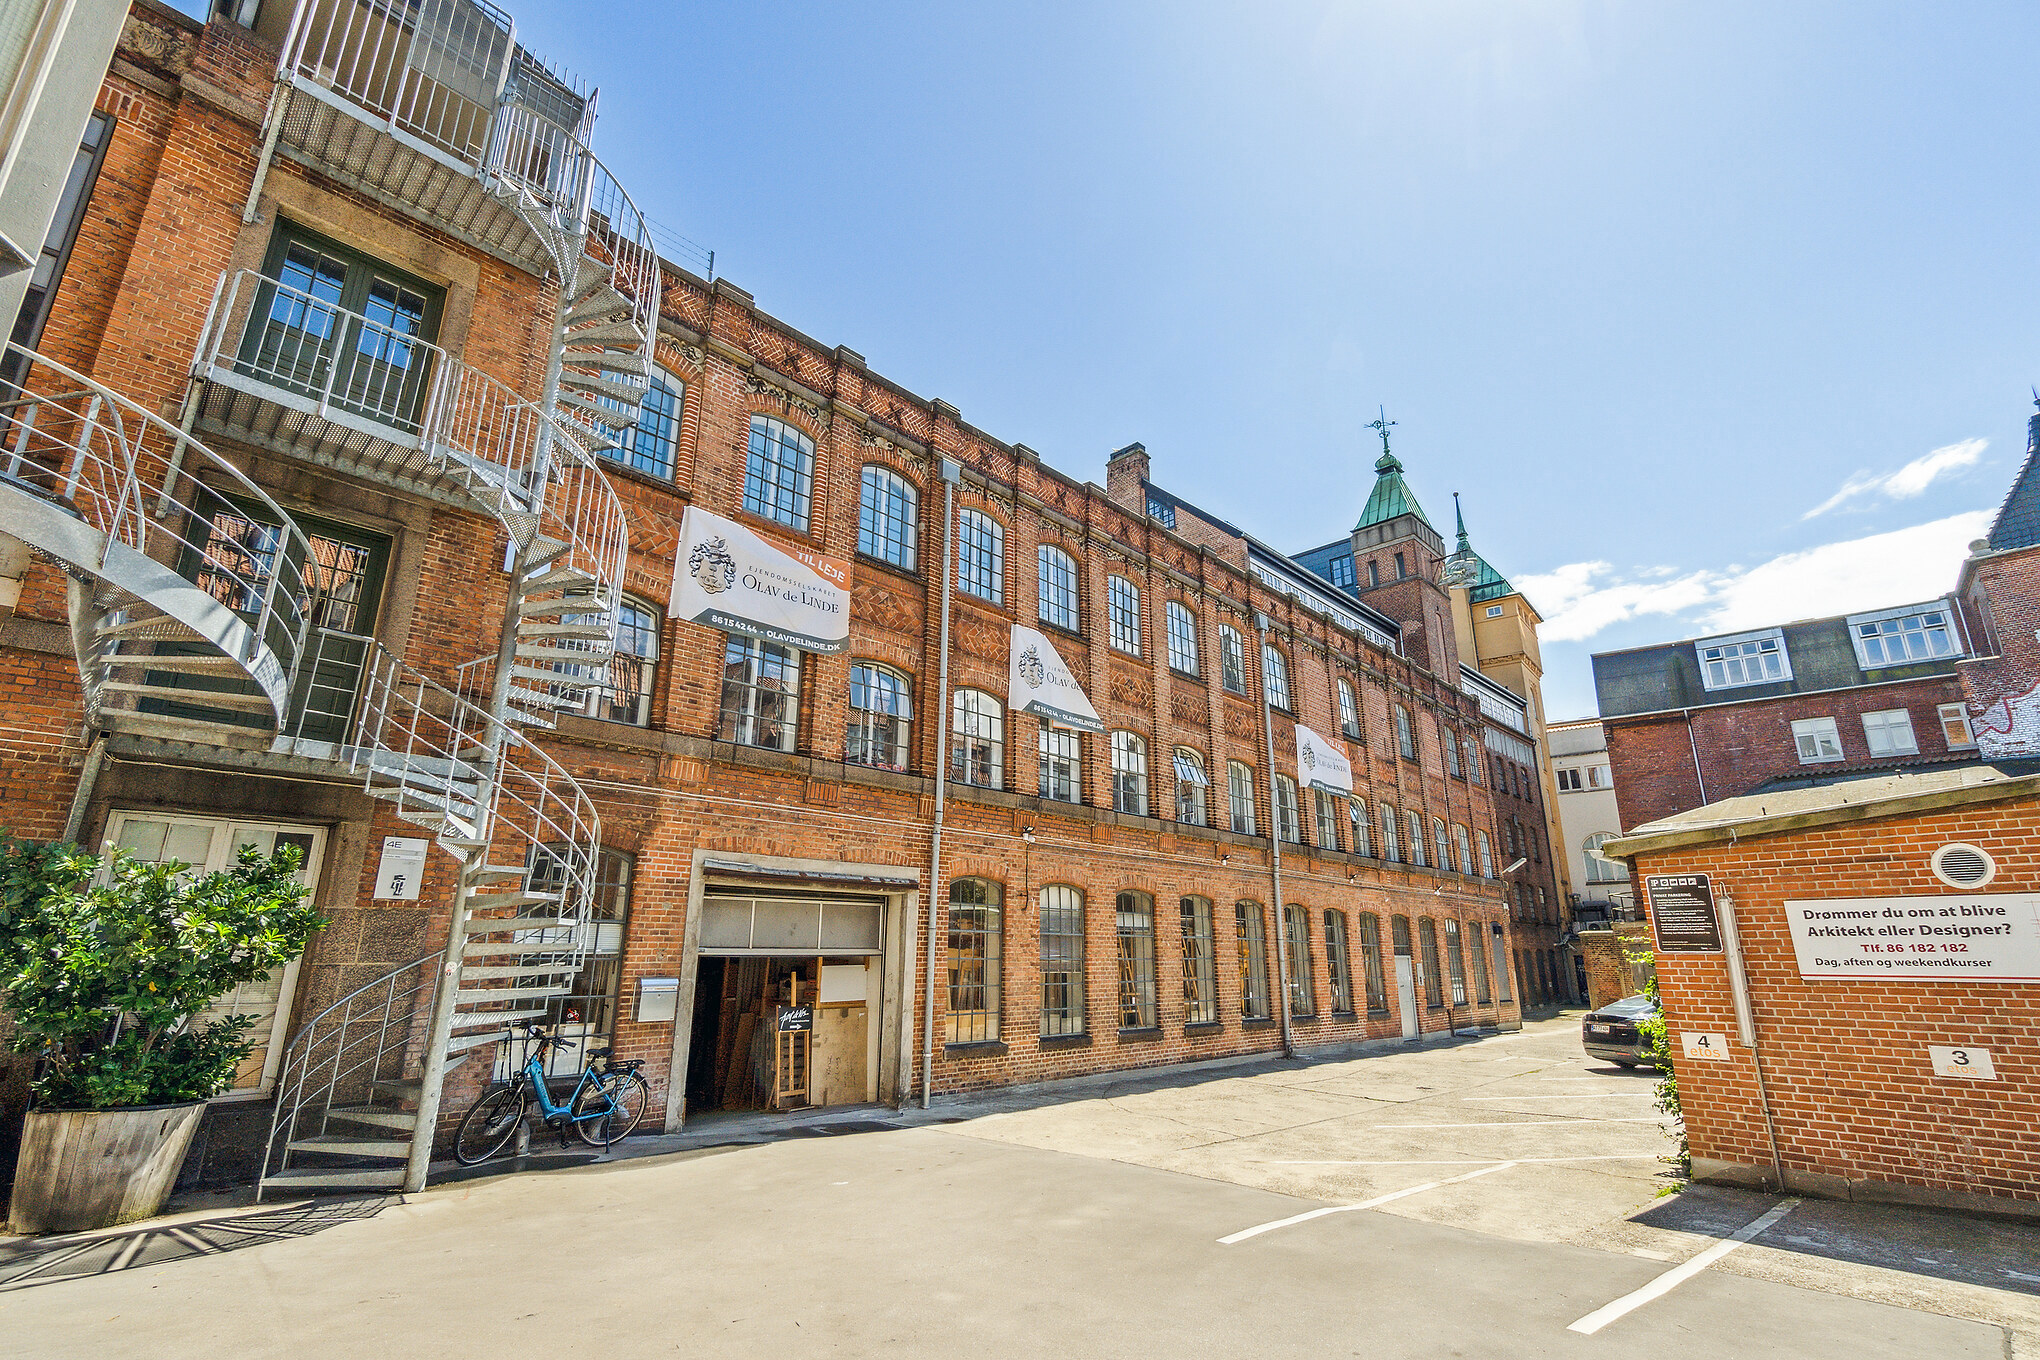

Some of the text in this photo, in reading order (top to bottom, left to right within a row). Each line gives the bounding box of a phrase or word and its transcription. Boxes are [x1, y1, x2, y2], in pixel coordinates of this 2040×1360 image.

[796, 551, 845, 583] TIL LEJE
[749, 565, 836, 598] EJENDOMSSELSKABET
[783, 590, 798, 603] de
[801, 591, 839, 613] LINDE
[766, 630, 841, 651] OLAVDELINDE.DK
[386, 840, 402, 849] 4E
[1802, 904, 2006, 920] Drømmer du om at blive
[1807, 922, 2012, 938] Arkitekt eller Designer?
[1860, 944, 1969, 953] Tlf. 86 182 182
[1815, 957, 1992, 968] Dag, aften og weekendkurser
[1697, 1035, 1711, 1048] 4
[1690, 1046, 1721, 1058] etos
[1951, 1050, 1969, 1065] 3
[1946, 1064, 1977, 1075] etos
